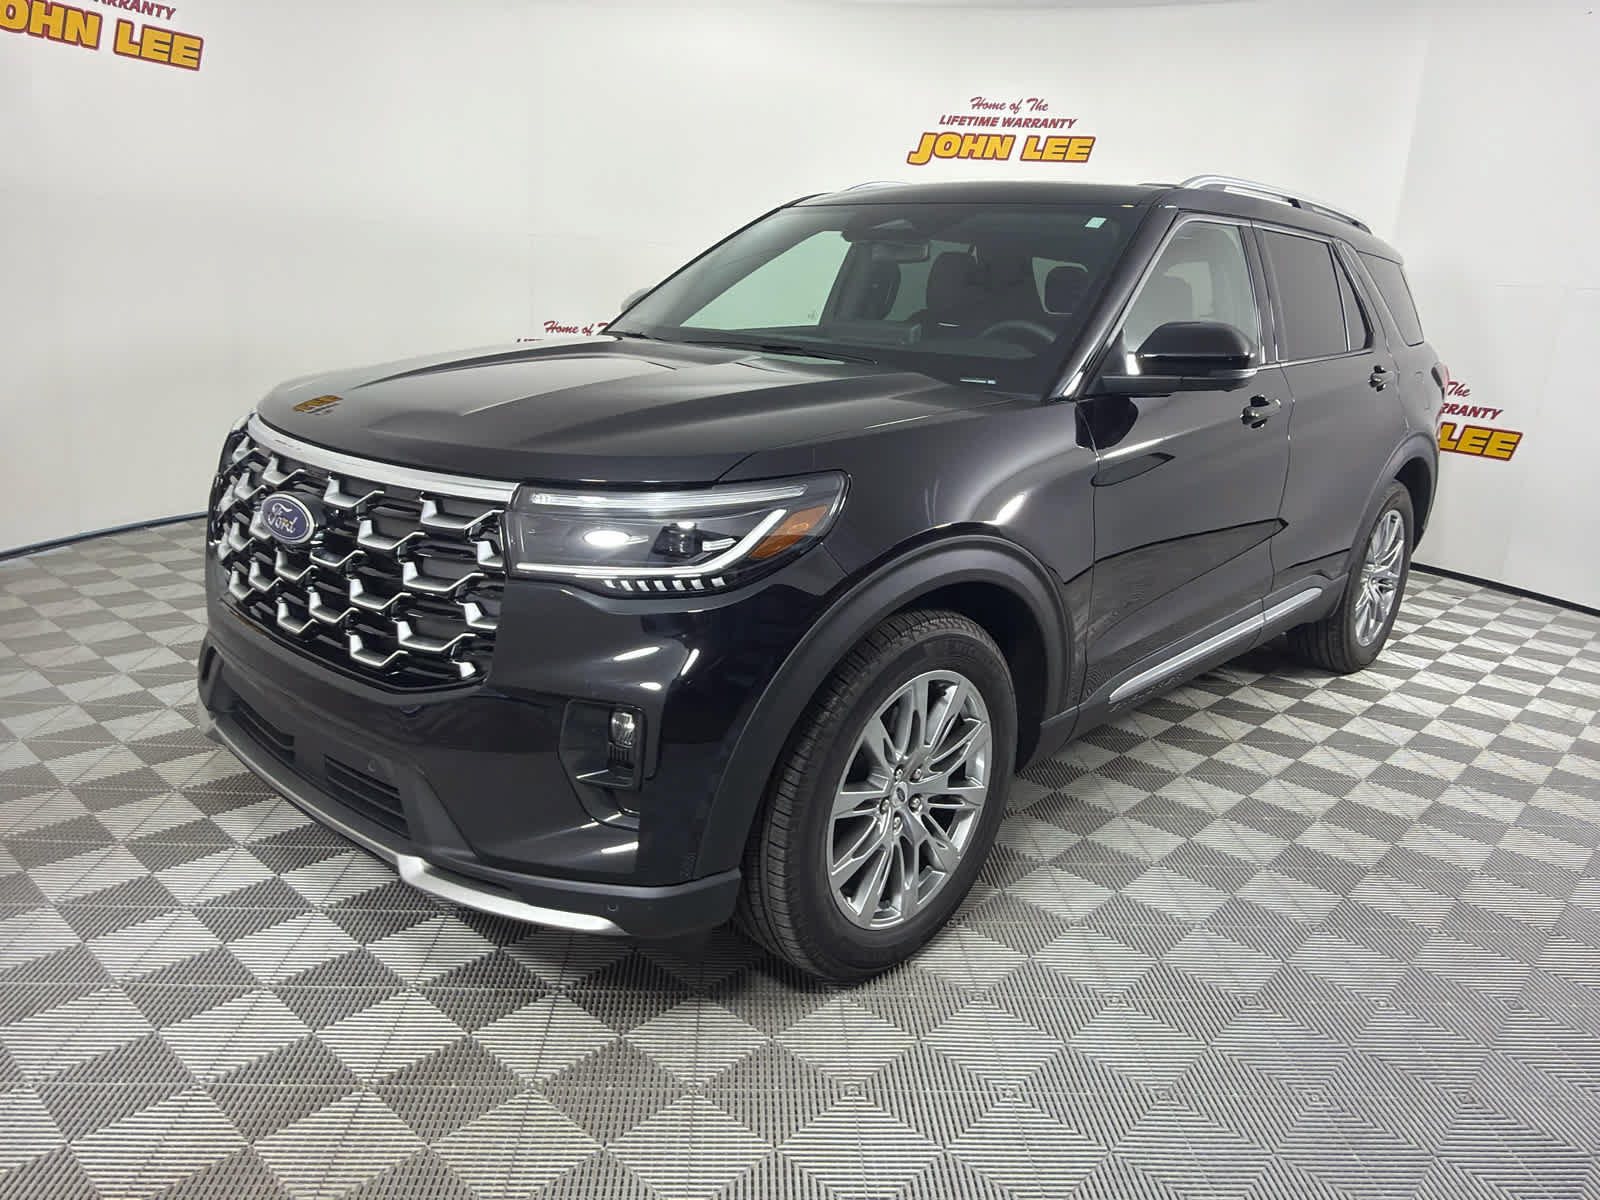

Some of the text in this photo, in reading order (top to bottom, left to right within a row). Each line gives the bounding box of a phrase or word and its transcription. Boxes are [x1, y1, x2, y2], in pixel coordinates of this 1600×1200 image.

[0, 0, 204, 71] OHN LEE
[970, 96, 1049, 114] Home of The
[938, 115, 1079, 129] LIFETIME WARRANTY
[907, 132, 1096, 165] JOHN LEE
[543, 320, 579, 335] Home
[581, 323, 594, 336] of
[1447, 381, 1471, 397] The
[1441, 402, 1504, 420] RRANTY
[1438, 421, 1523, 461] LEE
[268, 502, 299, 534] Ford
